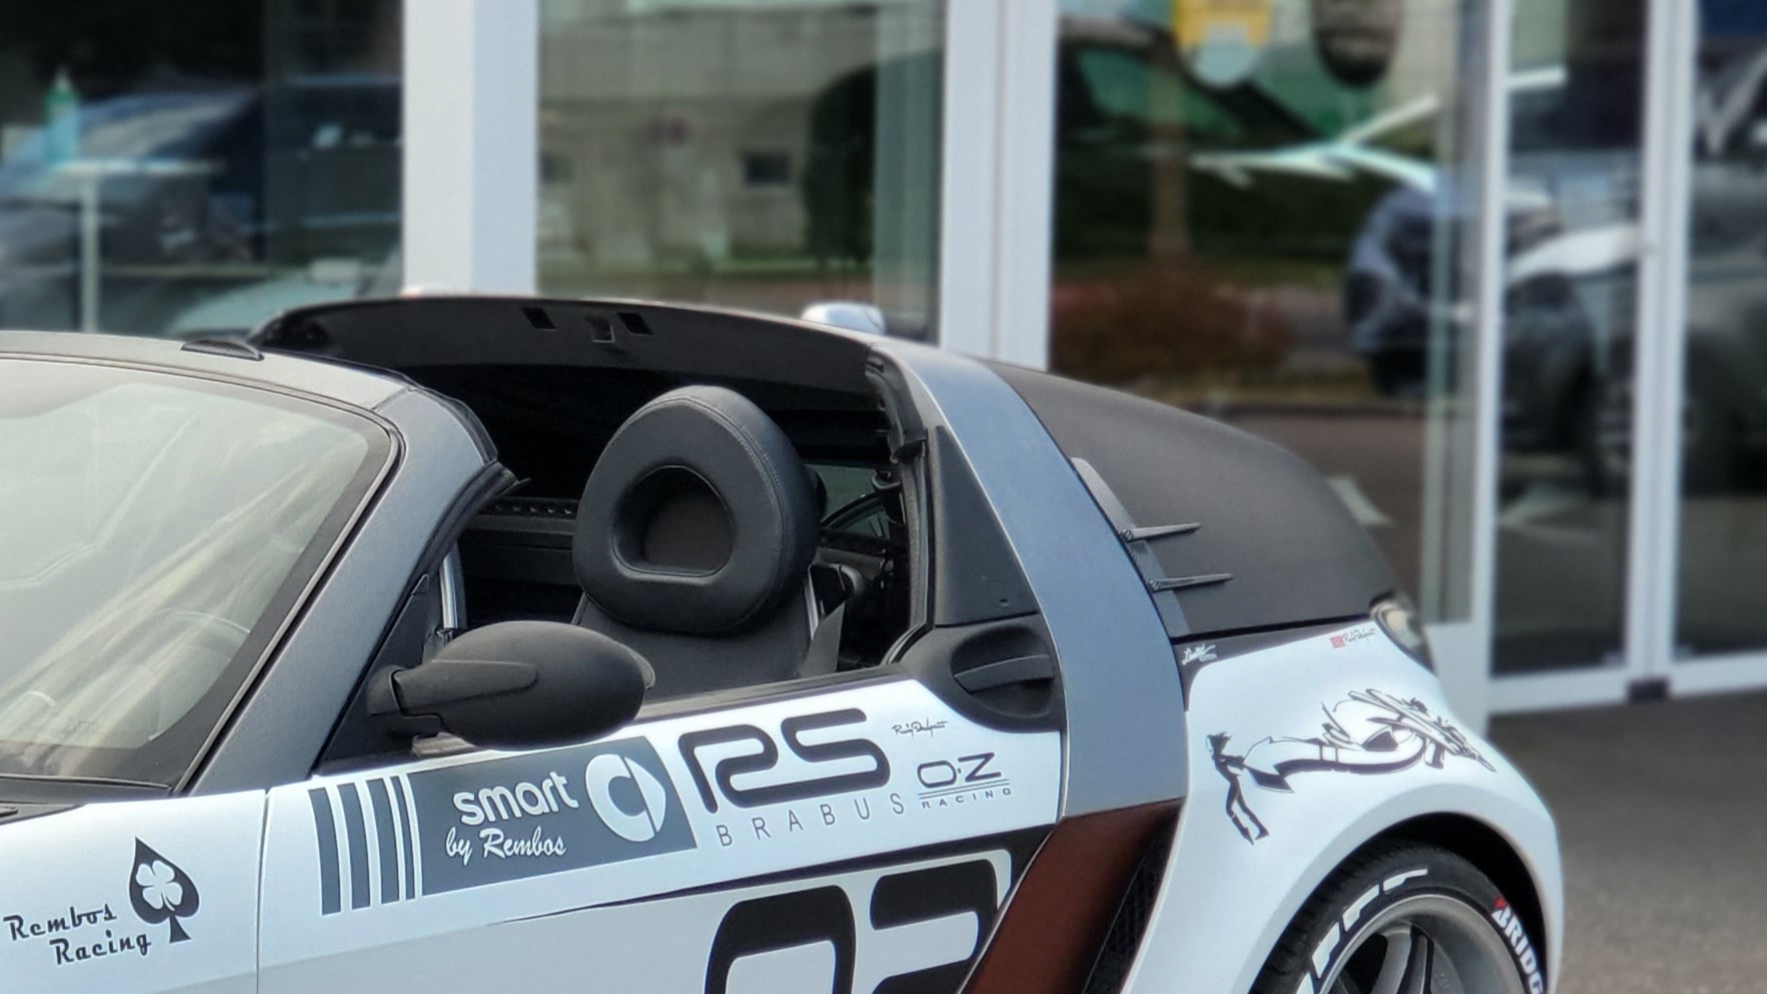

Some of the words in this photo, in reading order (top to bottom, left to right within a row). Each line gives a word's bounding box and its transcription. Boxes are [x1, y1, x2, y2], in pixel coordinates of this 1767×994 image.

[678, 708, 890, 814] RS
[452, 771, 579, 827] smart
[922, 788, 1012, 809] RACING
[716, 793, 905, 847] BRABUS
[445, 827, 473, 867] by
[481, 826, 567, 860] Rembos
[3, 903, 116, 941] Rembos
[49, 929, 152, 965] Racing
